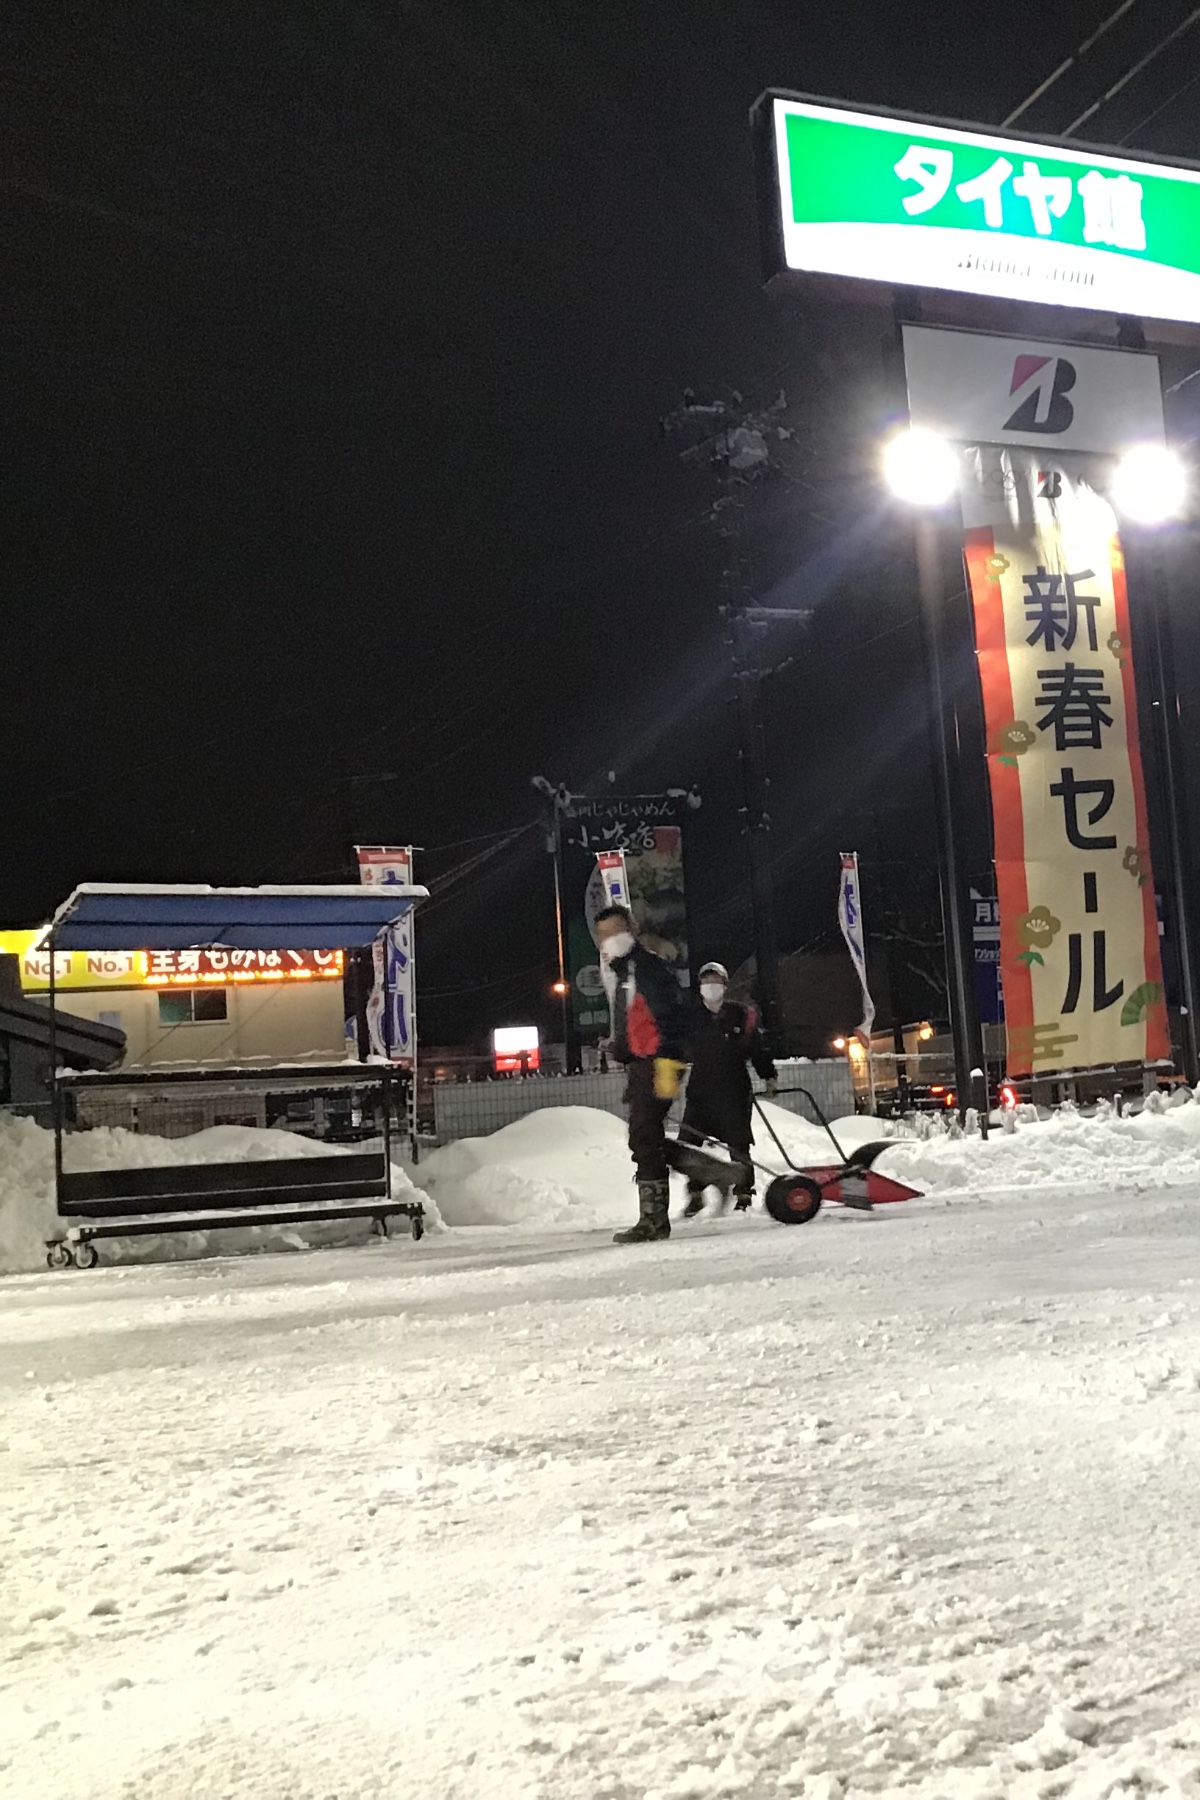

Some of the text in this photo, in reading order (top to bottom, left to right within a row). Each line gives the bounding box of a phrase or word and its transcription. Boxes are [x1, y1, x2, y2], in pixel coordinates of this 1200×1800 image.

[894, 144, 1147, 251] タイヤ館
[1022, 565, 1124, 1015] 新春セール
[24, 958, 72, 976] No.1
[87, 956, 134, 974] No.1
